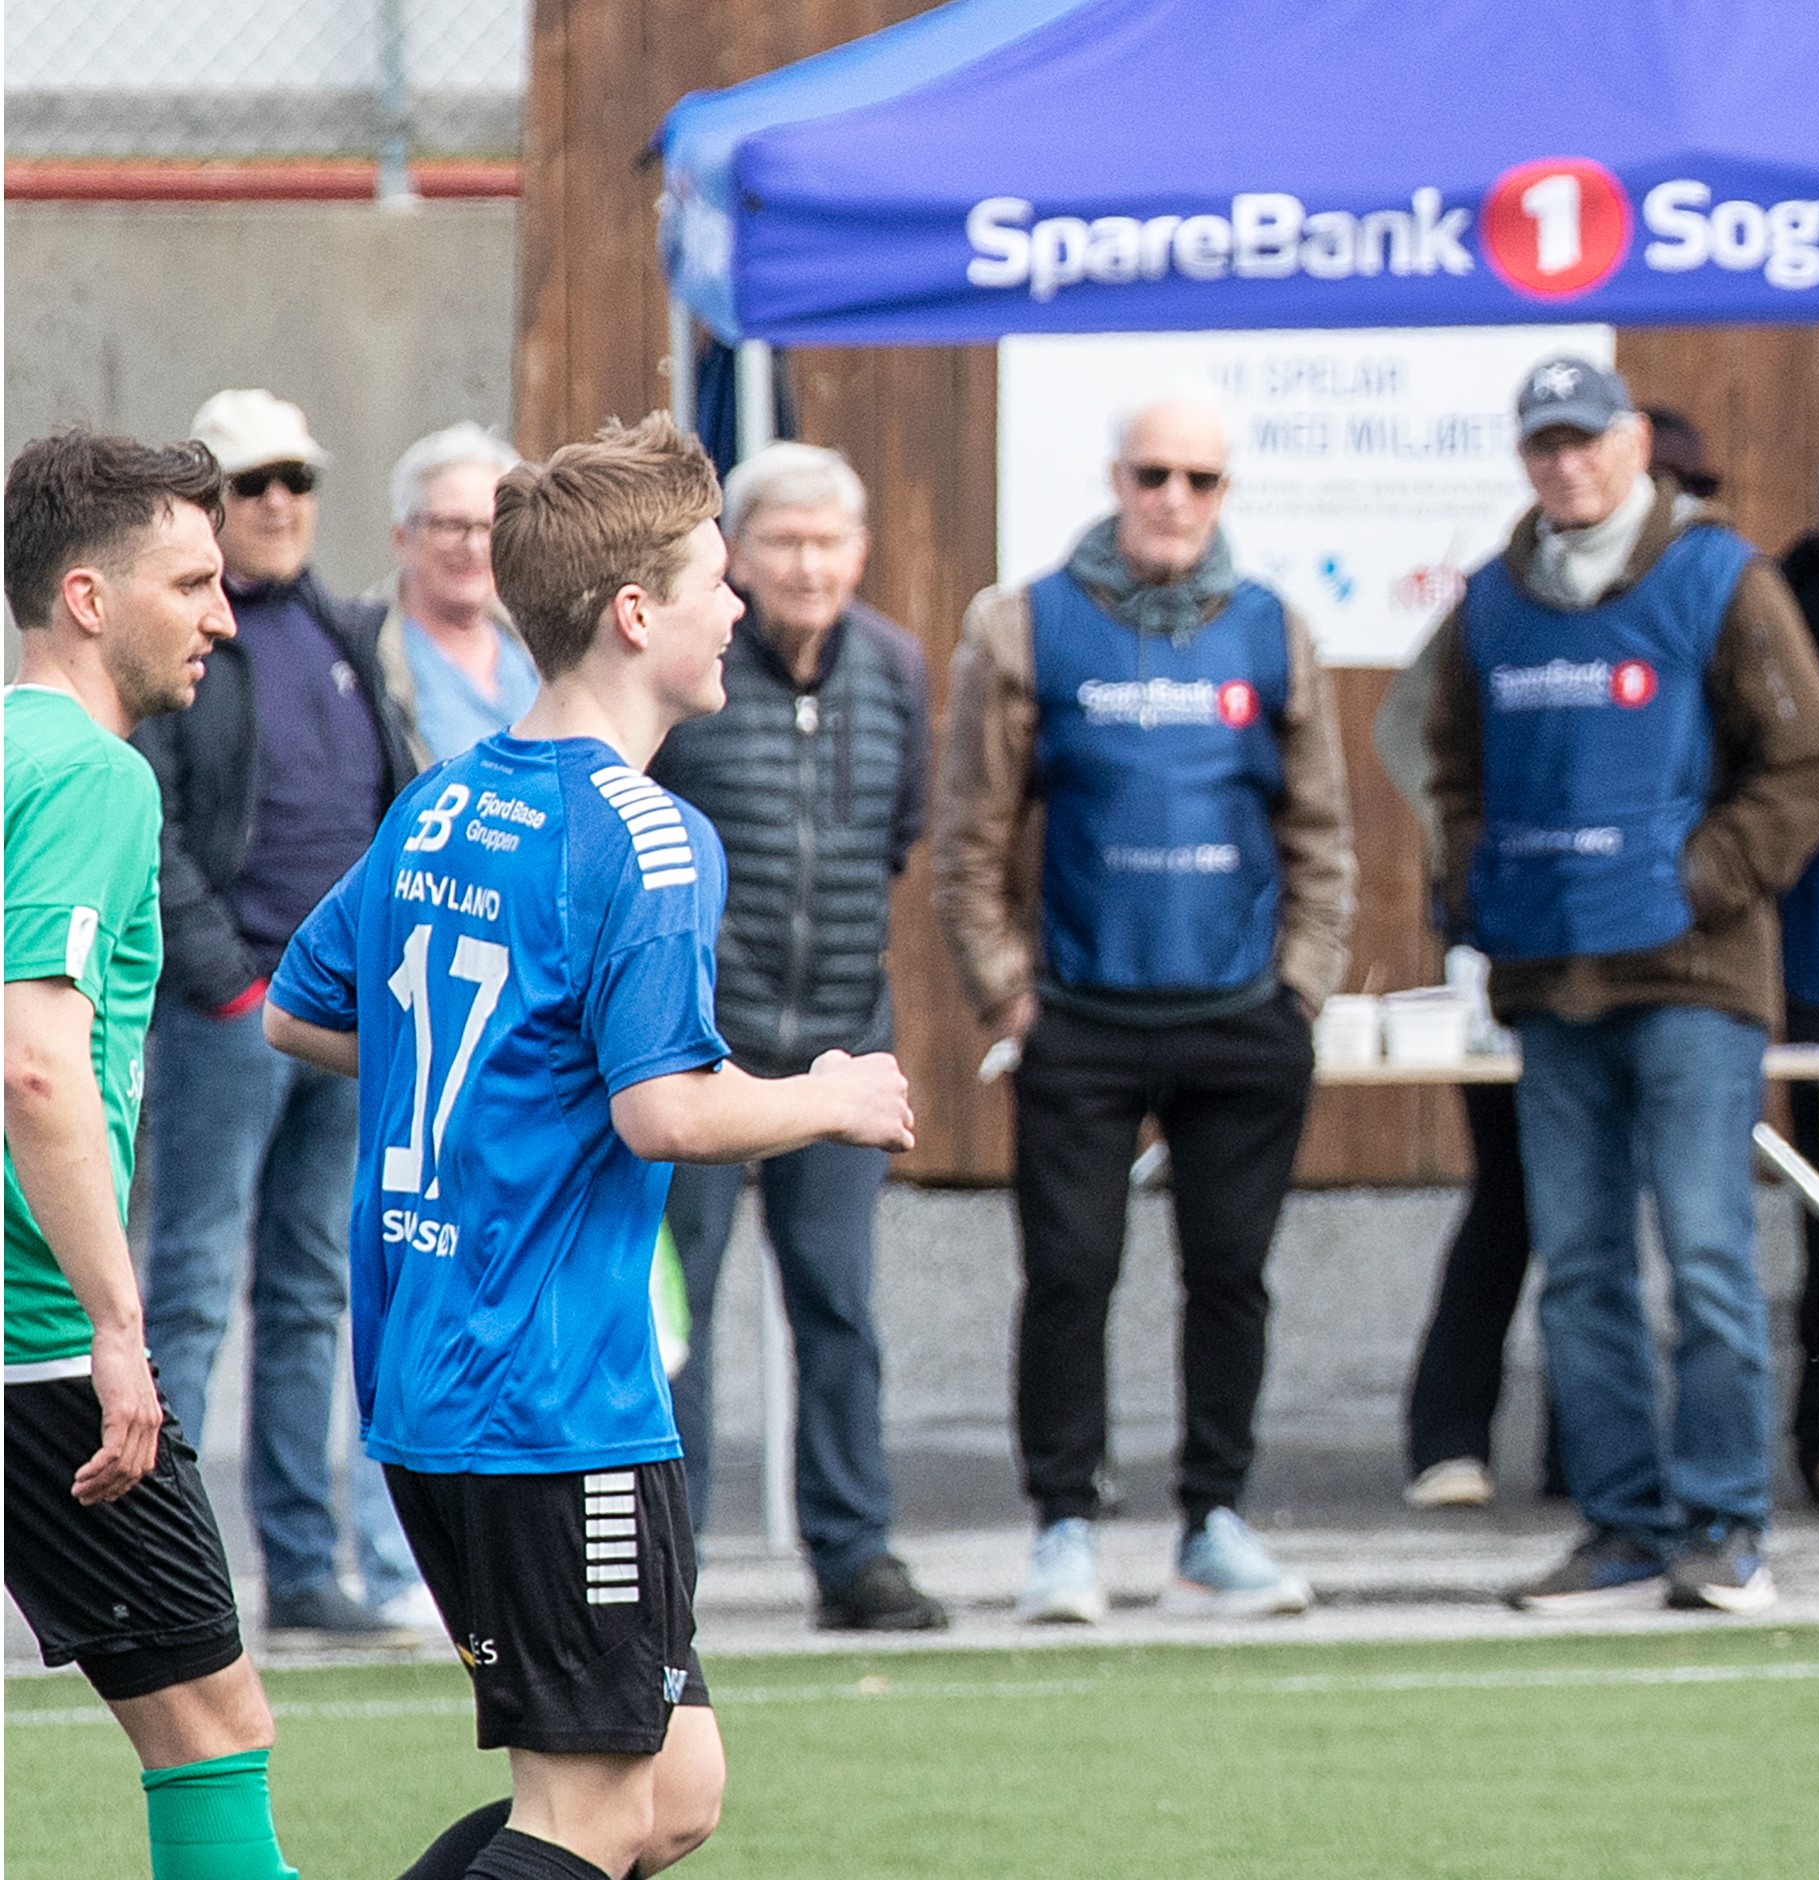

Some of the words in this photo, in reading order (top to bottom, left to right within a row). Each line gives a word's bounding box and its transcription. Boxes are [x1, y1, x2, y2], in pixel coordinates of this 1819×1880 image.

[966, 186, 1475, 301] SpareBank
[1521, 173, 1584, 275] 1
[466, 819, 520, 852] Gruppen
[476, 791, 514, 820] Fjord
[511, 799, 546, 829] Base
[395, 869, 500, 921] HAVLAND
[383, 925, 508, 1199] 17
